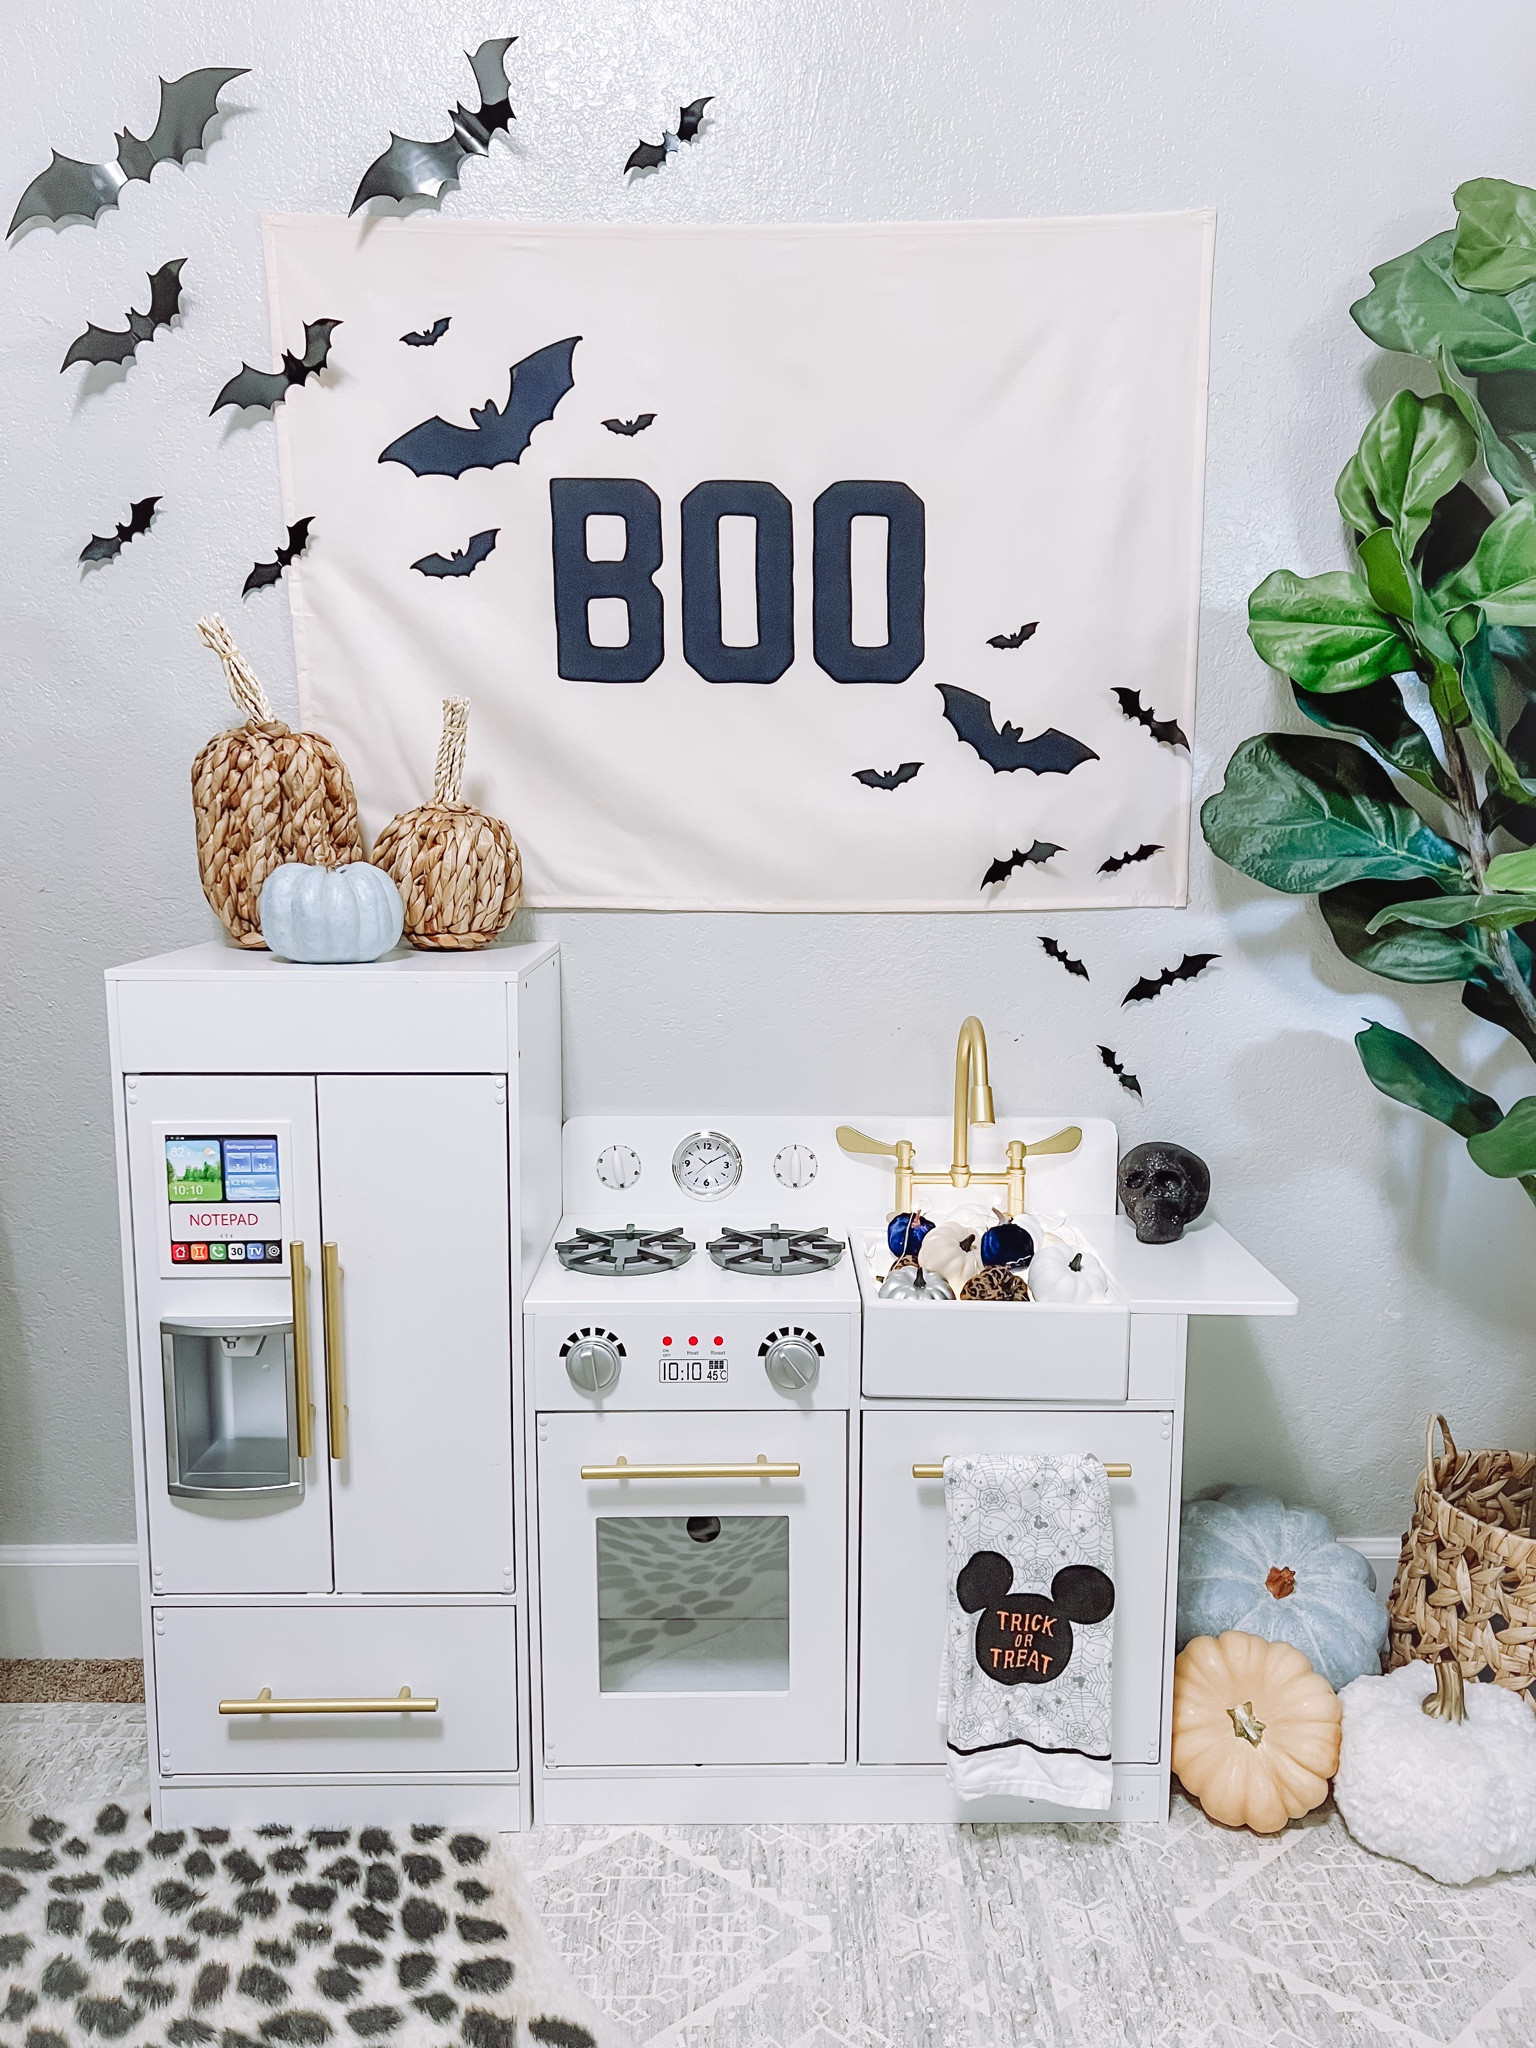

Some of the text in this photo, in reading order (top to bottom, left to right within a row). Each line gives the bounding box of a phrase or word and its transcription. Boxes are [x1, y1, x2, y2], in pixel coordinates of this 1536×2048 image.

[550, 478, 925, 684] BOO
[703, 1142, 712, 1150] 12
[684, 1159, 690, 1167] 9
[723, 1161, 730, 1169] 3
[703, 1178, 710, 1187] 6
[172, 1185, 203, 1195] 10:10
[189, 1213, 259, 1227] NOTEPAD
[231, 1247, 243, 1256] 30
[249, 1247, 262, 1256] TV
[663, 1362, 702, 1381] 10:10
[996, 1610, 1058, 1638] TRICK
[1014, 1633, 1034, 1648] OR
[989, 1648, 1053, 1675] TREAT
